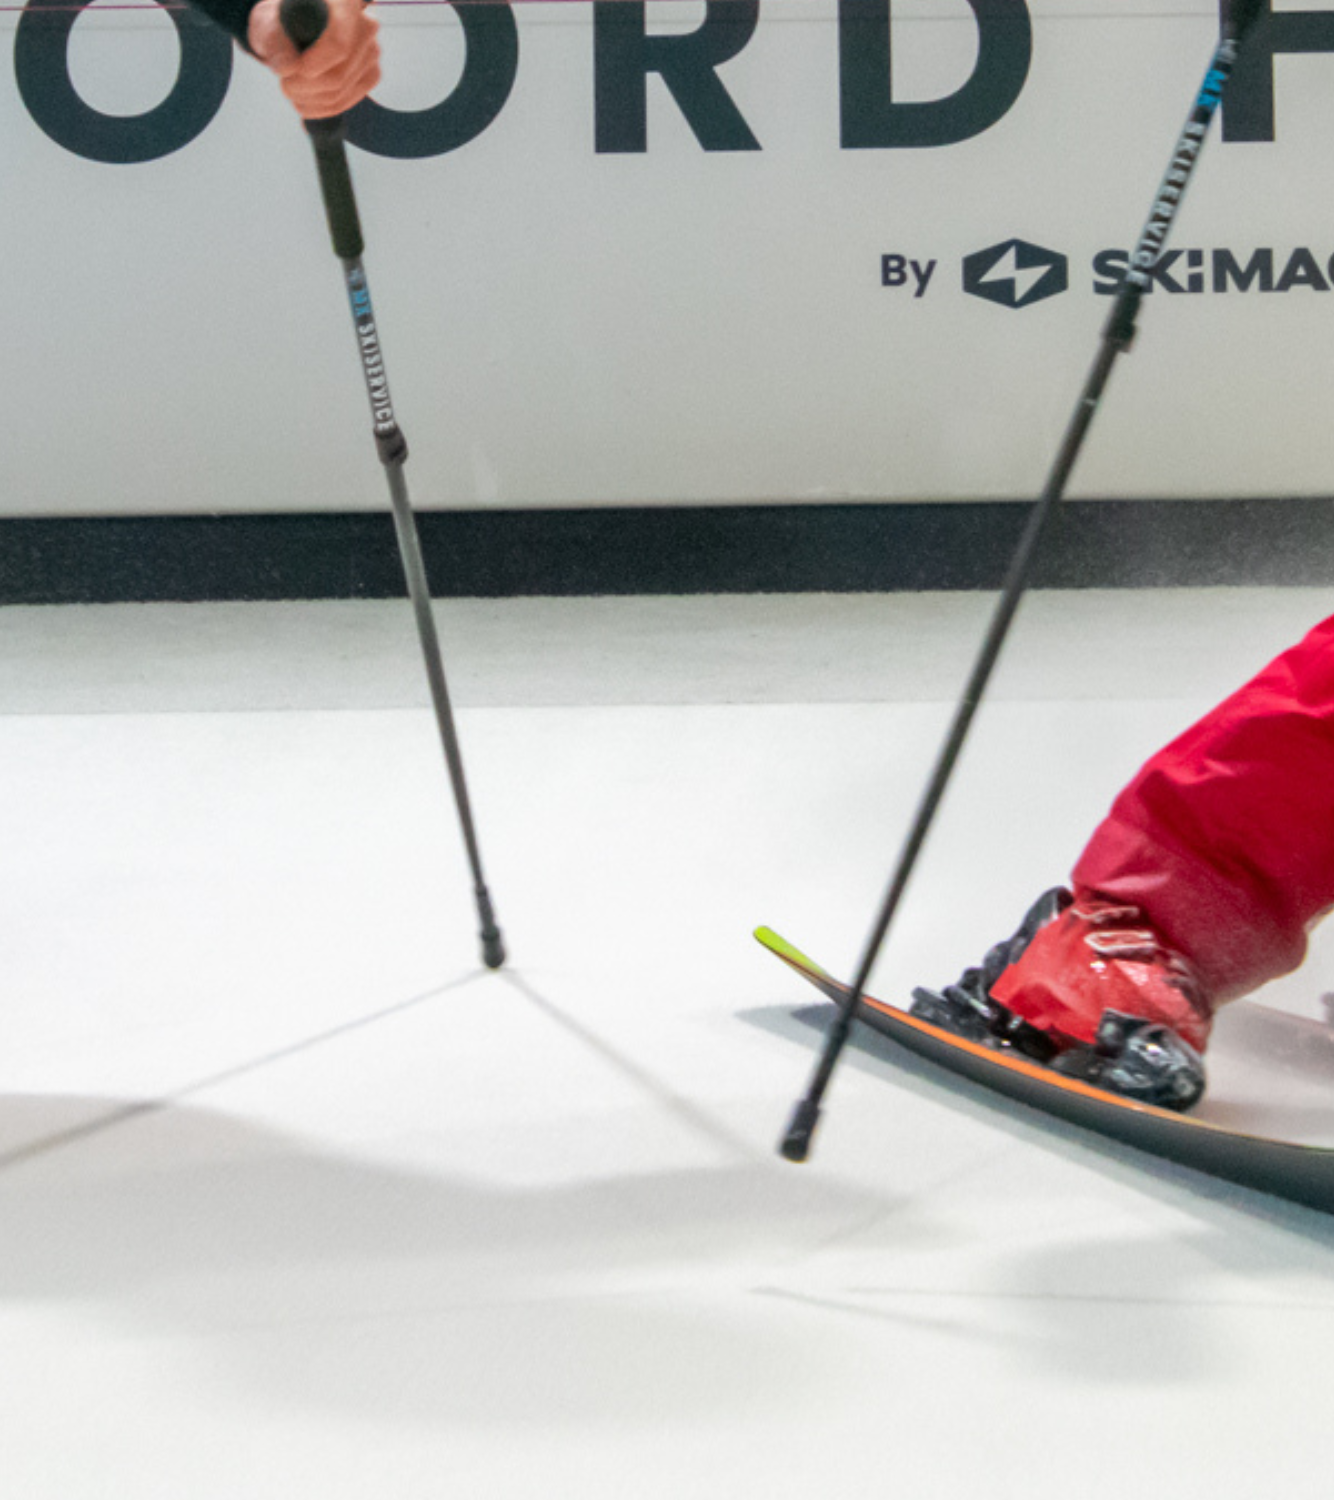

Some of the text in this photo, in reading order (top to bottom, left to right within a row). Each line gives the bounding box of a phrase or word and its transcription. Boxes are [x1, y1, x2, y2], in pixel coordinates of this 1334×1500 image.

[1126, 121, 1207, 285] SKISERVICE
[880, 253, 937, 298] By
[358, 323, 395, 431] SKISERVICE
